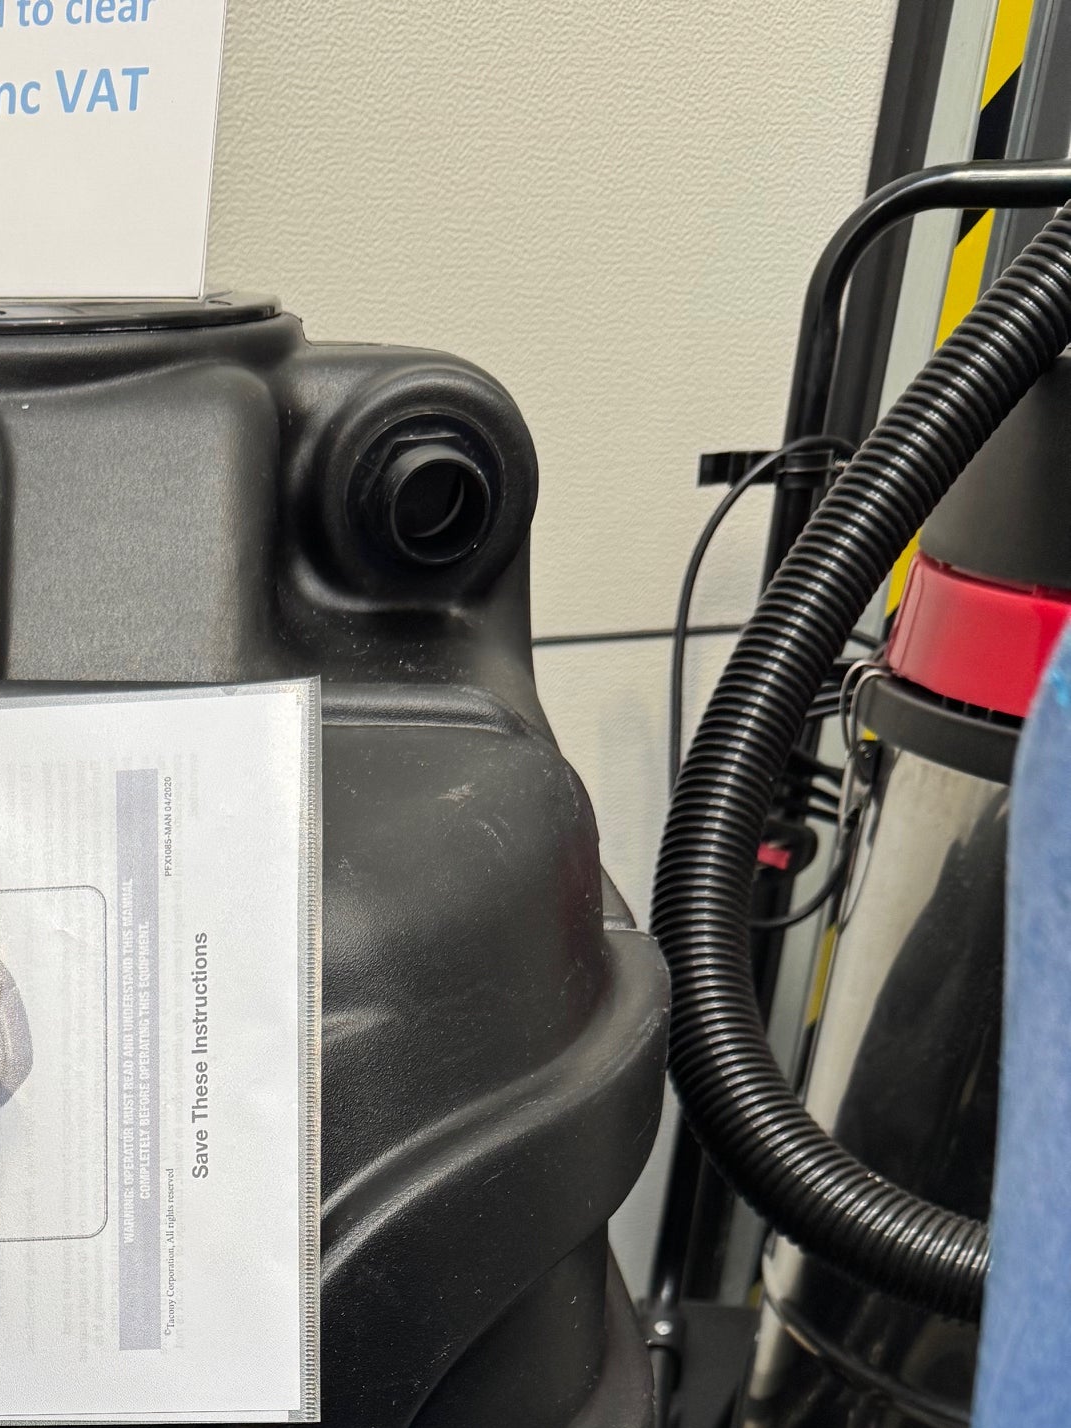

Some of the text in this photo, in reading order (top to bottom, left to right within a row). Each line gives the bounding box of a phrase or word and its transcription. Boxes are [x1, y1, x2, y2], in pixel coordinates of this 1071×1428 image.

[16, 0, 55, 28] to
[64, 0, 155, 25] clear
[55, 67, 150, 113] VAT
[163, 776, 173, 812] 04/2020
[122, 878, 133, 926] MANUAL
[122, 930, 133, 955] THIS
[122, 956, 134, 1031] UNDERSTAND
[122, 1034, 134, 1057] AND
[138, 921, 151, 1199] COMPLETELY BEFORE OPERATING THIS EQUIPMENT.
[190, 932, 209, 1179] Save These Instructions
[123, 1060, 134, 1090] READ
[123, 1093, 134, 1125] MUST
[123, 1127, 135, 1184] OPERATOR
[165, 1168, 175, 1203] reserved
[165, 1204, 177, 1229] rights
[165, 1230, 175, 1244] All
[165, 1245, 176, 1297] Corporation,
